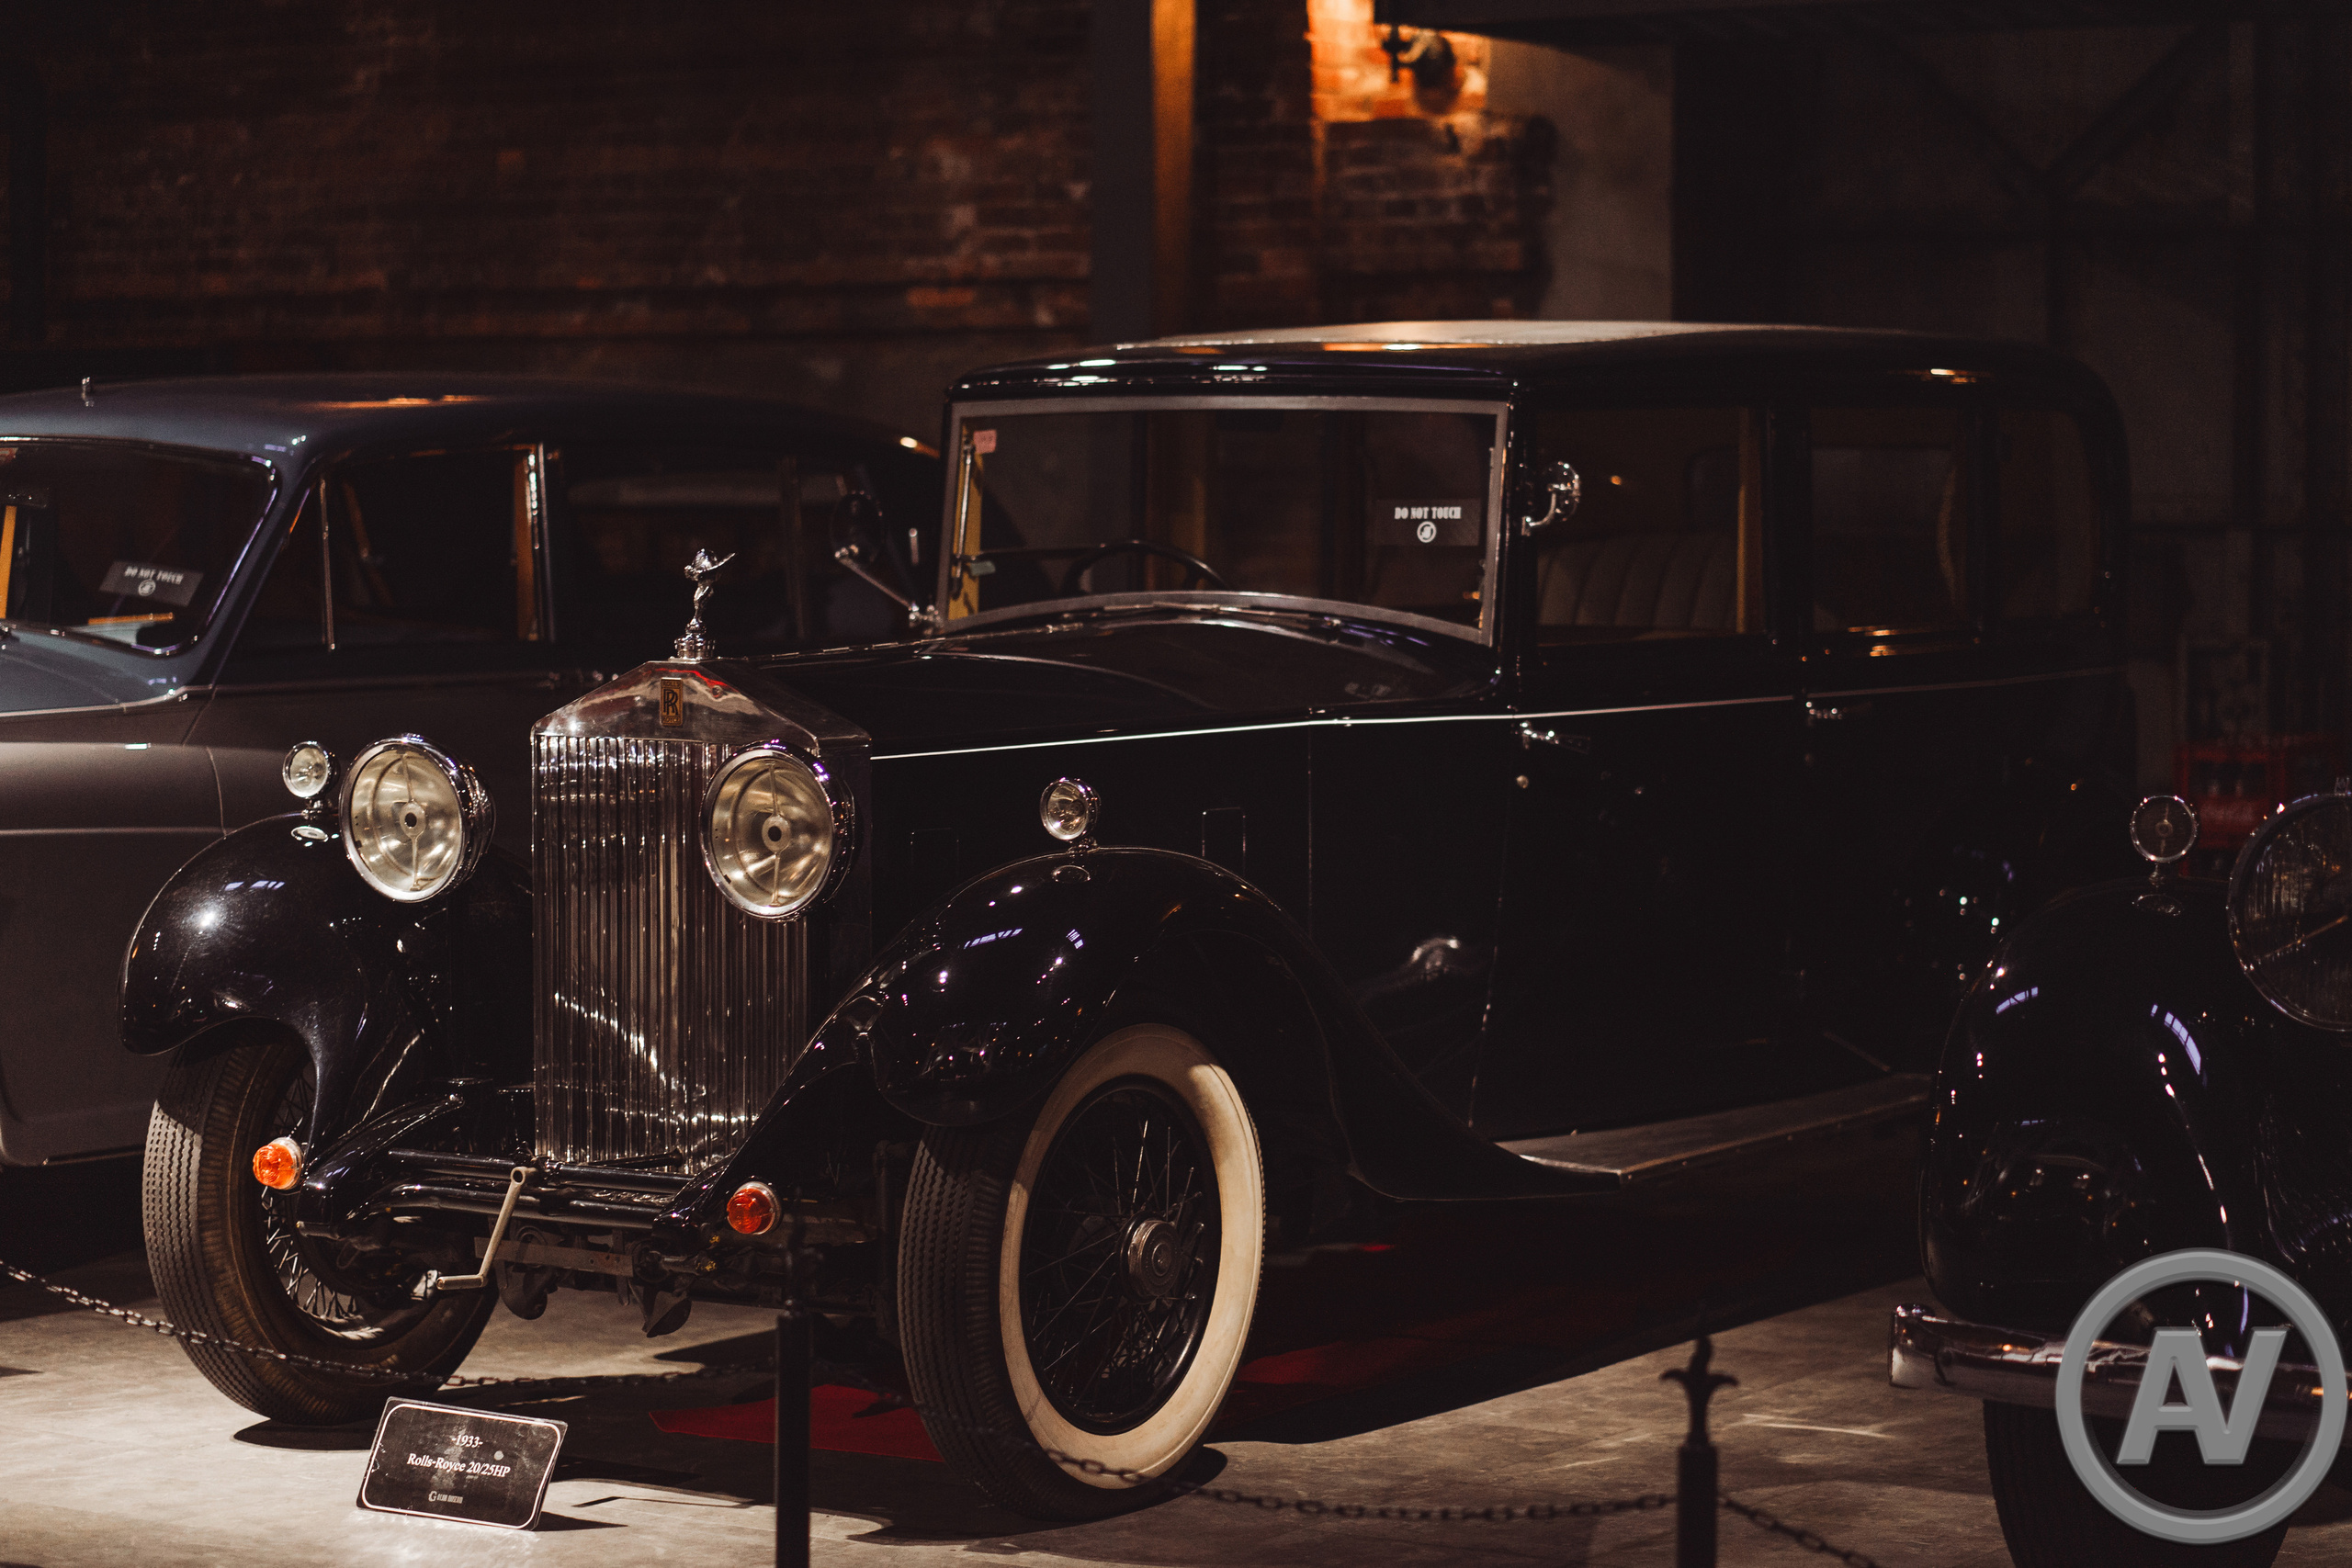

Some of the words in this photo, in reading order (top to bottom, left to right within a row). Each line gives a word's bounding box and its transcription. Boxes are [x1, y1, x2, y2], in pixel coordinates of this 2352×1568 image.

[1394, 506, 1409, 520] DO
[1410, 506, 1430, 520] NOT
[1430, 506, 1462, 520] TOUCH
[406, 1452, 466, 1472] Rolls-Royce
[466, 1461, 511, 1478] 20/25HP
